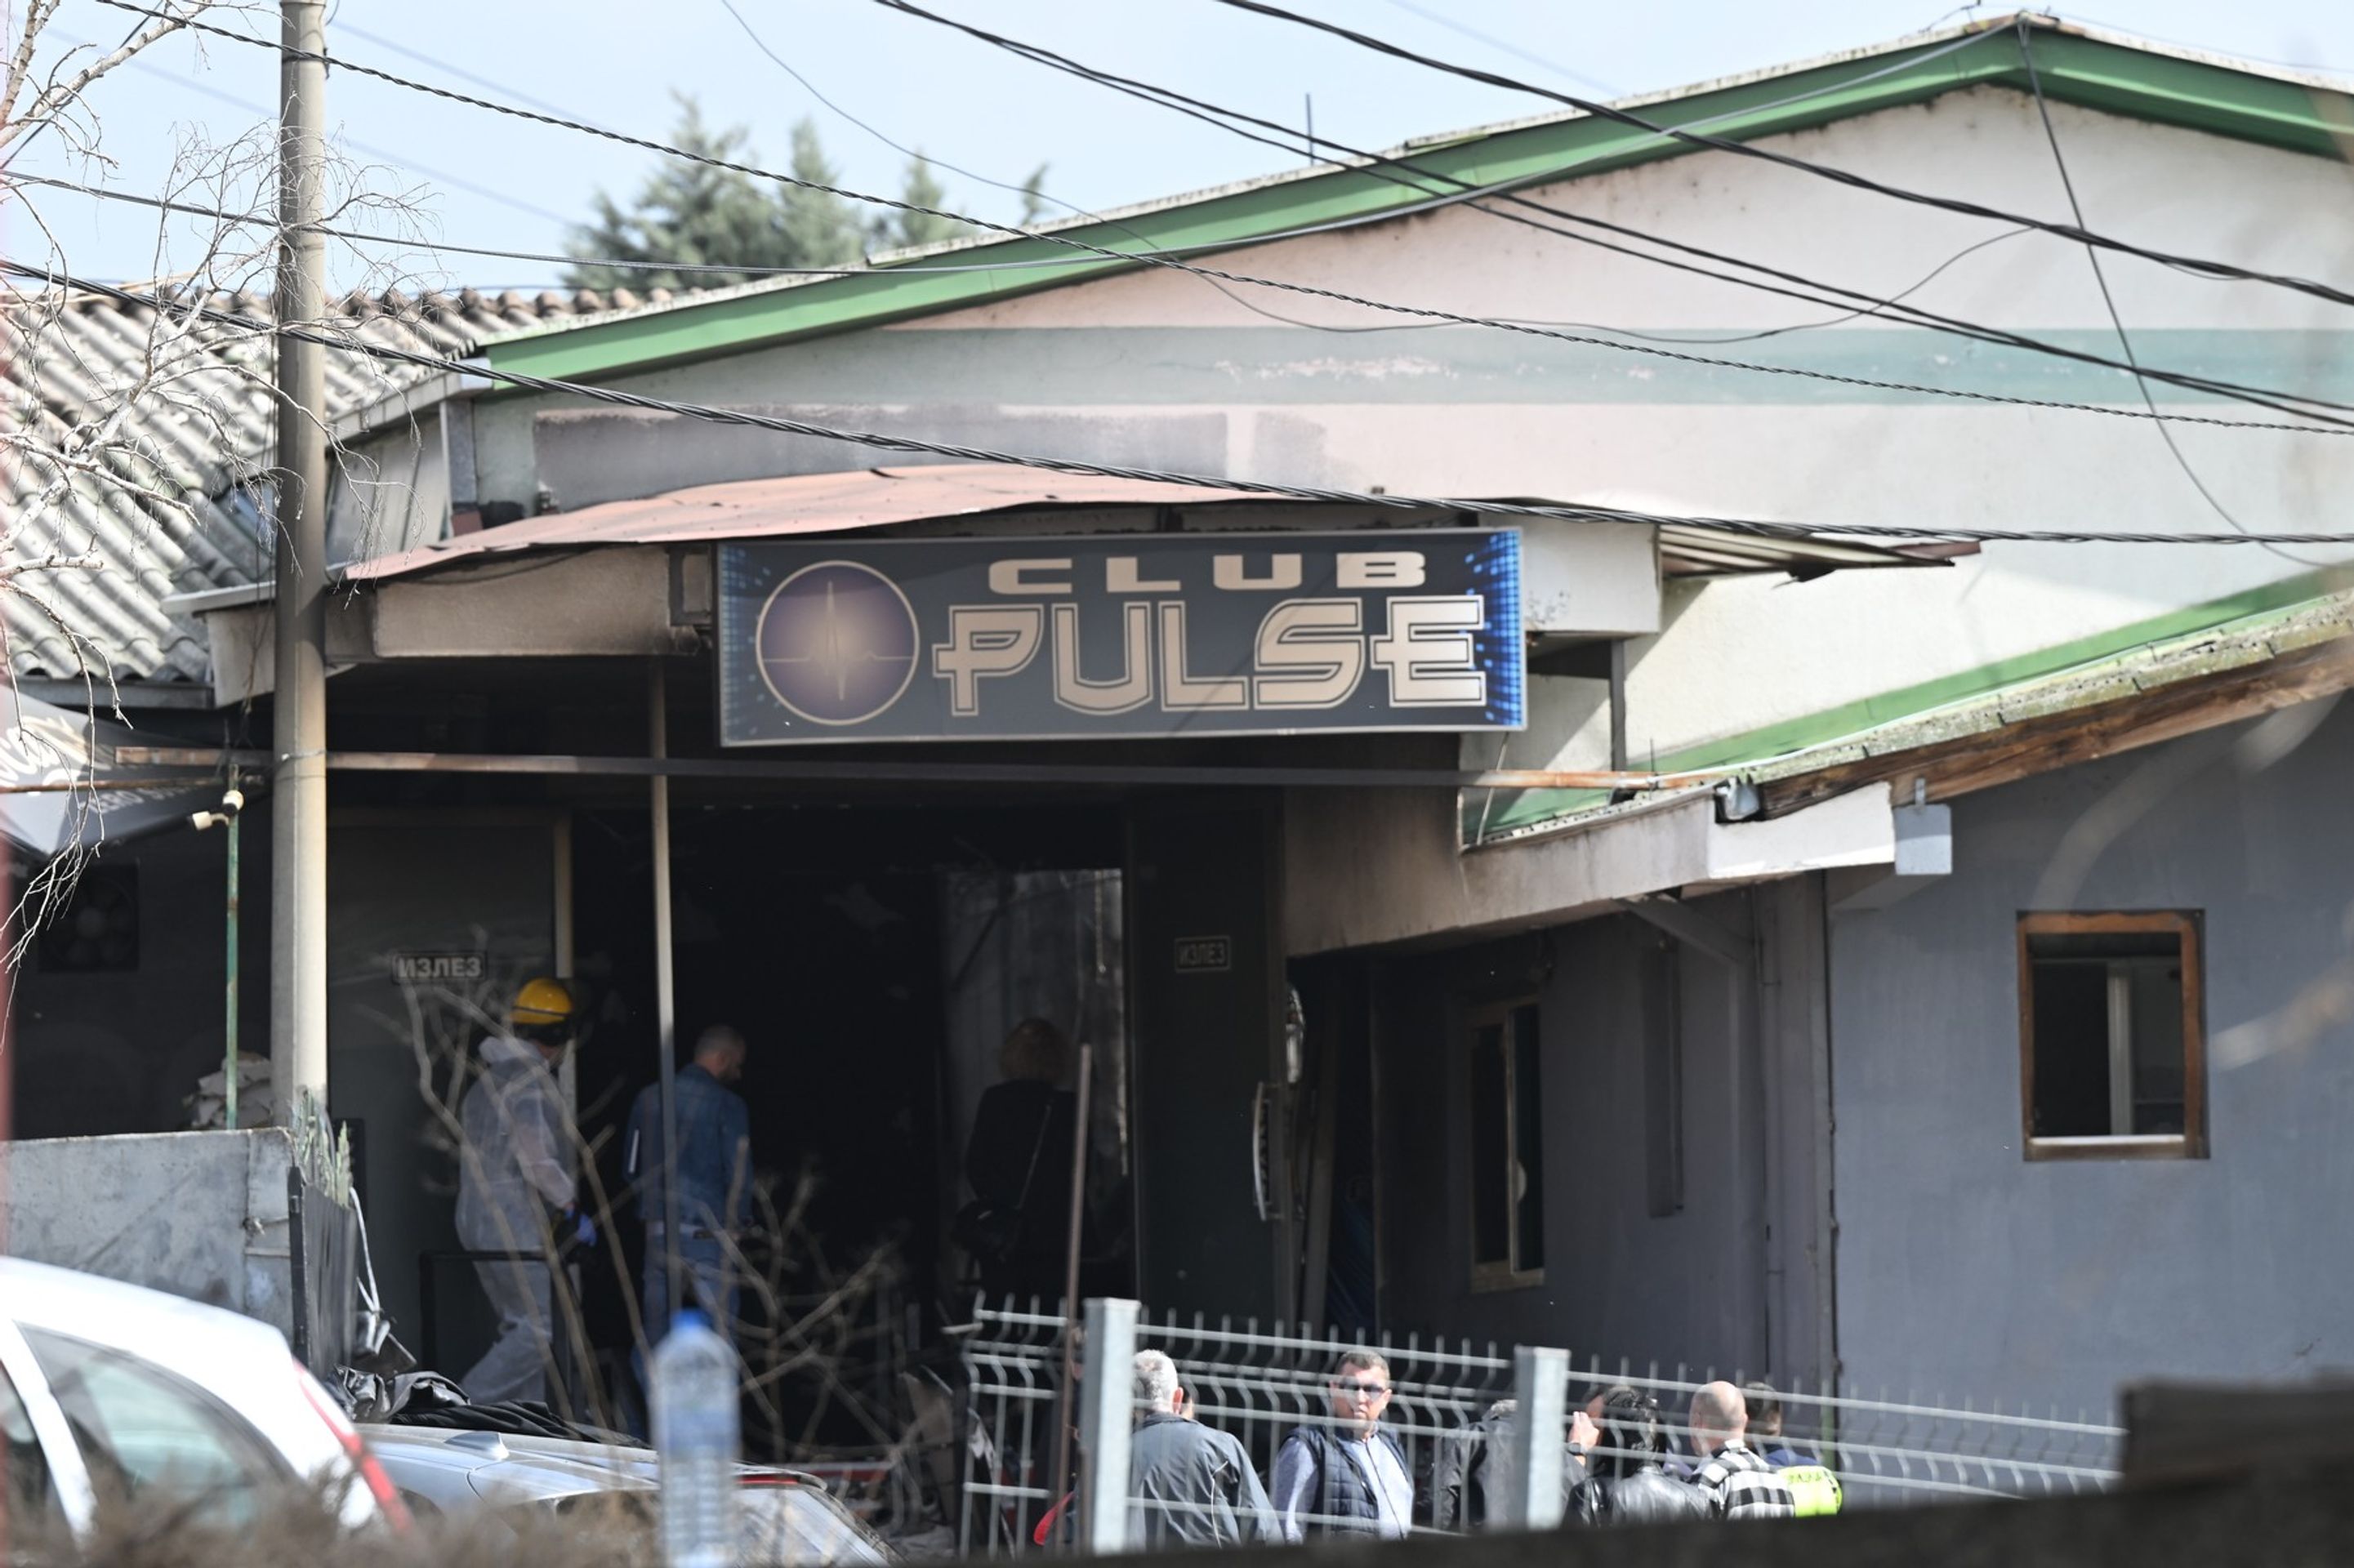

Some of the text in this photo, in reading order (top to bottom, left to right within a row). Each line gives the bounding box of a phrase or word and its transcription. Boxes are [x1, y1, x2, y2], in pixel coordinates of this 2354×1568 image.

[989, 551, 1425, 594] CLUB
[932, 595, 1487, 716] PULSE
[398, 957, 481, 978] ИЗЛЕЗ
